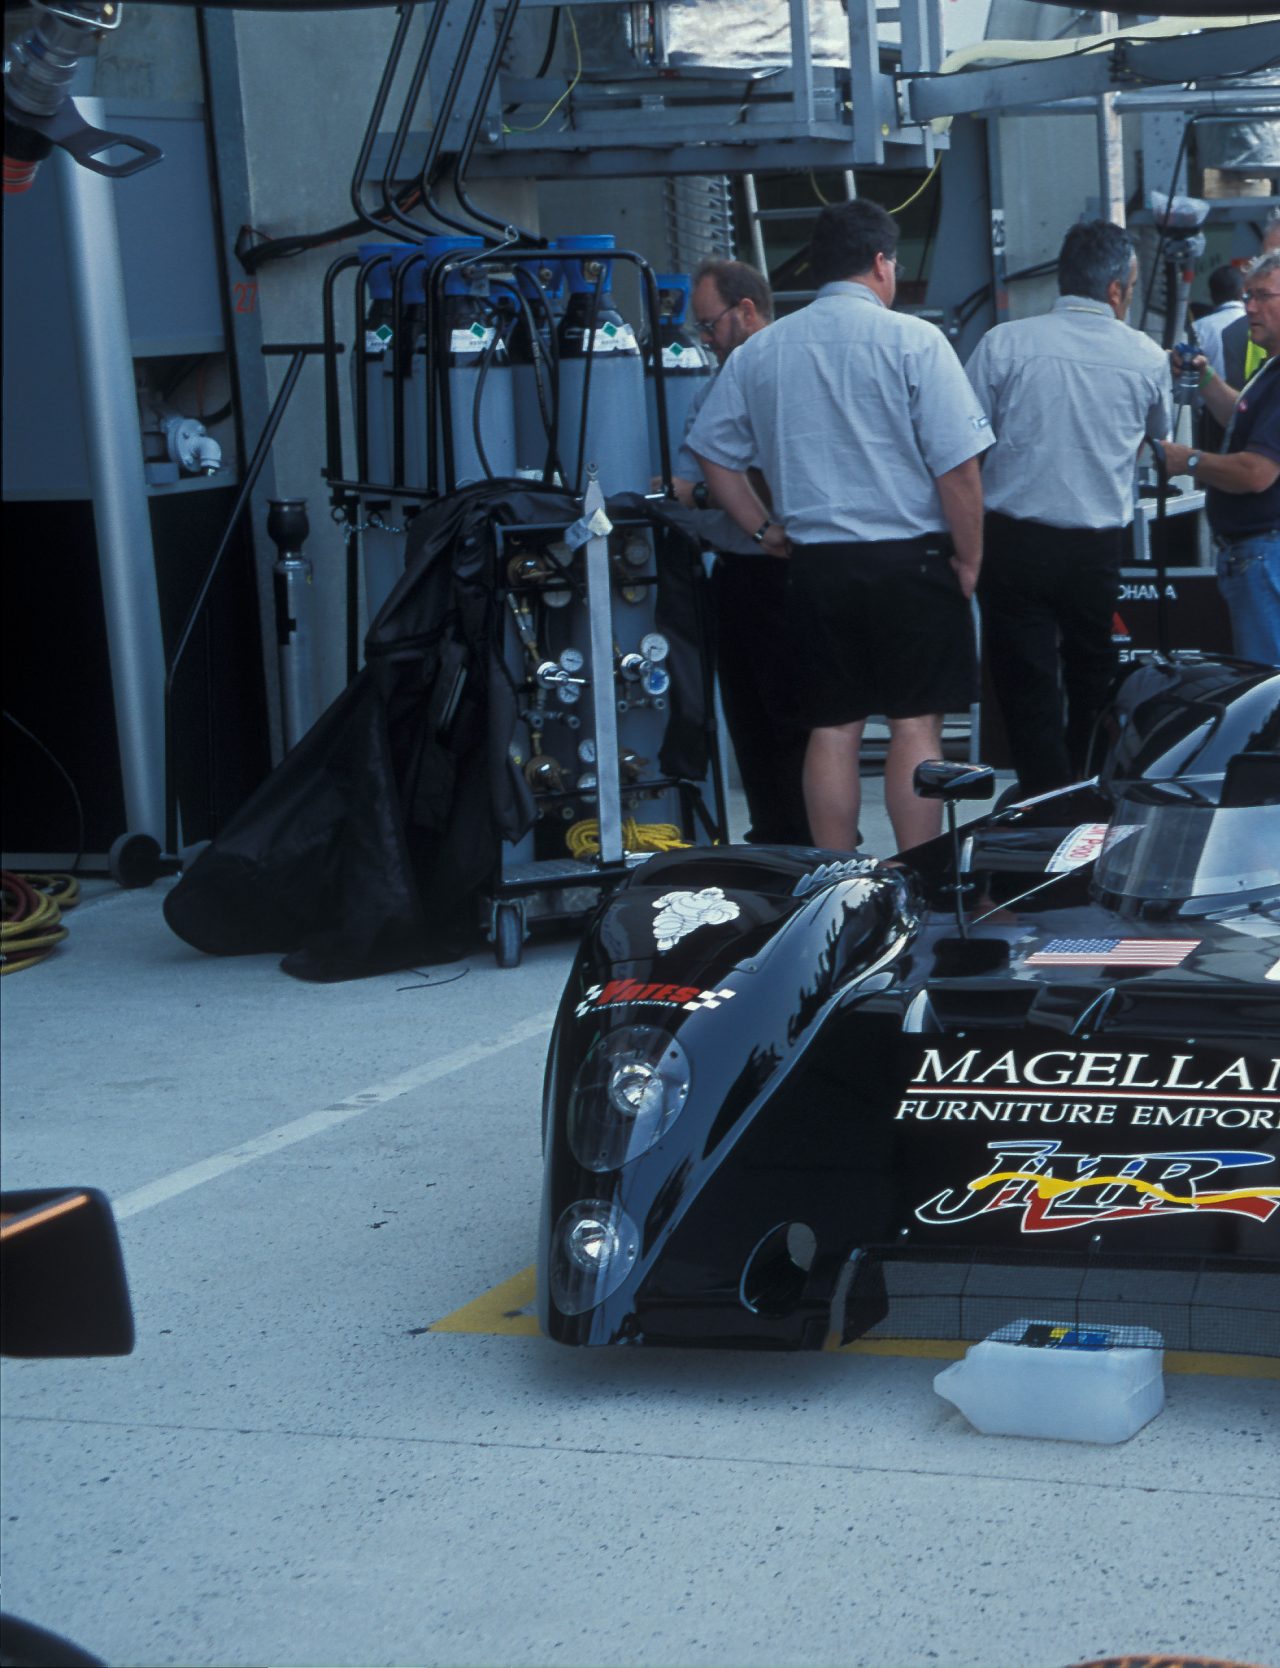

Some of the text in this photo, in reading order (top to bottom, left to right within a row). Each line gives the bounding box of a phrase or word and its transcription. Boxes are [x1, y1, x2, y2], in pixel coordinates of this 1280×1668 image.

[597, 979, 700, 1004] YATES
[630, 1000, 678, 1008] ENGINES
[895, 1099, 1118, 1126] FURNITURE
